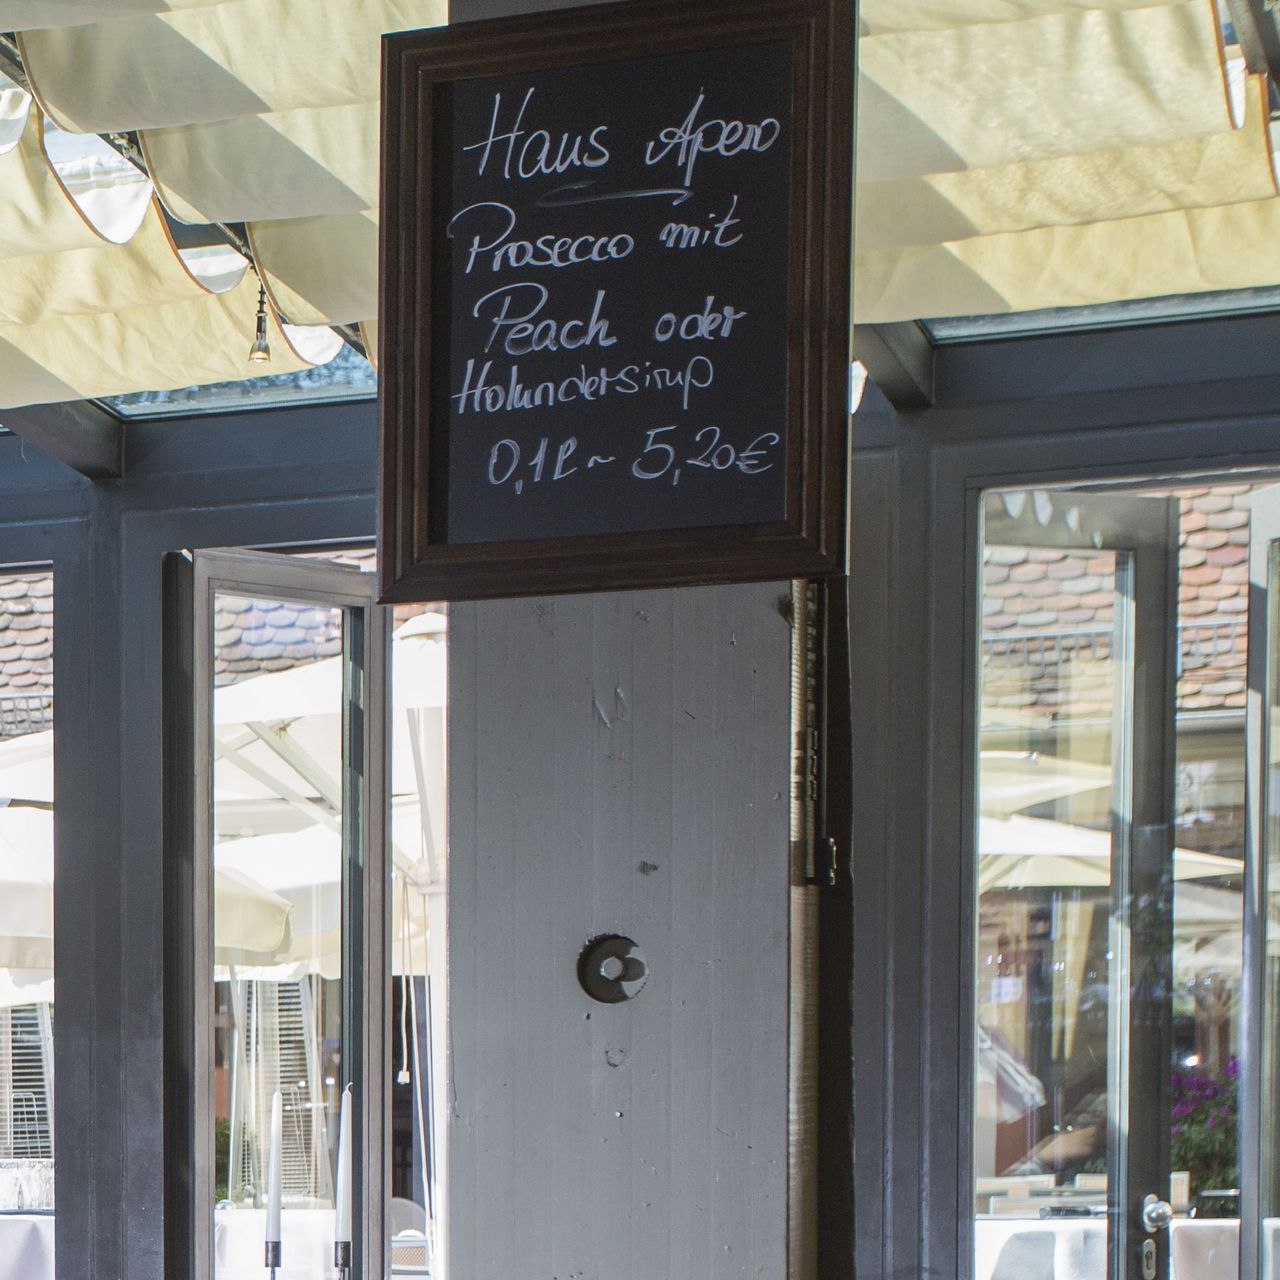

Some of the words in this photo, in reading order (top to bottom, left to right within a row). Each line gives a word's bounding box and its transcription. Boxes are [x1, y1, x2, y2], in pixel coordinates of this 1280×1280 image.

[463, 86, 611, 179] Haus
[645, 90, 781, 187] Apero
[448, 202, 634, 273] Prosecco
[658, 195, 744, 250] mit
[473, 282, 617, 356] Peach
[654, 296, 747, 341] oder
[451, 356, 714, 413] Holundersirup
[632, 426, 780, 486] 5,20€
